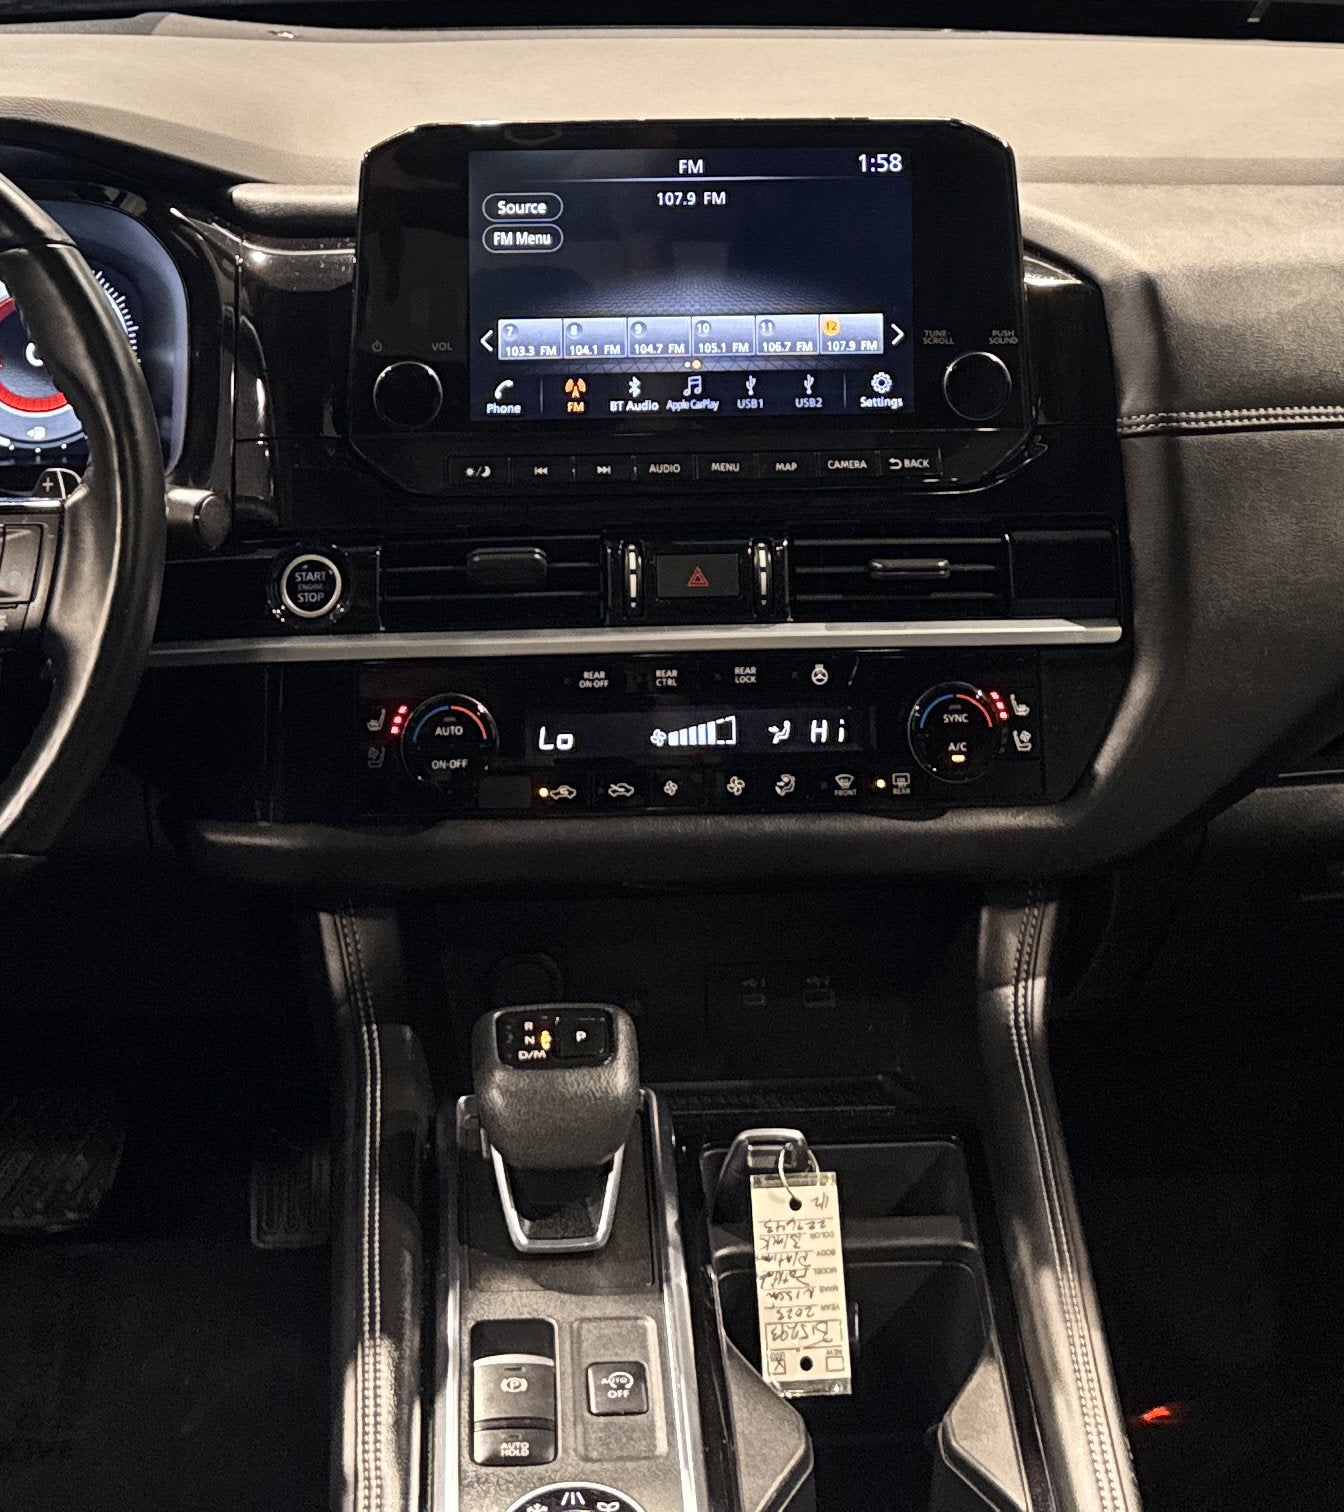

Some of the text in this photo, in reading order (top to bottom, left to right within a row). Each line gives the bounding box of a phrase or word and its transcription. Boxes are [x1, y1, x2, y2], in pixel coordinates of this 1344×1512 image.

[678, 159, 704, 175] FM
[858, 152, 903, 173] 1:58
[656, 191, 727, 207] 107.9 FM
[497, 199, 548, 216] Source
[493, 230, 552, 246] FM Menu
[506, 326, 514, 337] 7
[570, 325, 578, 336] 8
[635, 323, 643, 334] 9
[696, 323, 710, 334] 10
[761, 322, 773, 333] 11
[826, 321, 838, 331] 12
[992, 329, 1015, 337] PUSH
[431, 342, 453, 351] VOL
[762, 341, 813, 352] 106.7 FM
[827, 340, 878, 351] 107.9 FM
[923, 337, 955, 345] SCROLL
[989, 337, 1018, 345] SOUND
[505, 345, 557, 357] 103.3 FM
[570, 344, 621, 355] 104.1 FM
[634, 343, 685, 354] 104.7 FM
[698, 342, 749, 353] 105.1 FM
[567, 401, 585, 412] FM
[609, 400, 660, 412] BT Audio
[665, 400, 720, 412] Apple CarPlay
[737, 399, 764, 409] USB1
[795, 397, 823, 408] USB2
[859, 396, 904, 410] Settings
[486, 402, 522, 415] Phone
[649, 463, 681, 475] AUDIO
[711, 462, 740, 473] MENU
[775, 461, 798, 472] MAP
[827, 459, 867, 471] CAMERA
[904, 458, 930, 469] BACK
[295, 571, 327, 582] START
[297, 592, 325, 603] STOP
[583, 671, 606, 679] REAR
[656, 669, 678, 678] REAR
[734, 666, 757, 675] REAR
[656, 678, 678, 687] CTRL
[734, 674, 757, 683] LOCK
[943, 713, 968, 724] SYNC
[434, 725, 464, 736] AUTO
[810, 718, 845, 743] Hi
[538, 725, 574, 751] Lo
[948, 741, 967, 752] A/C
[524, 1021, 534, 1031] R
[524, 1035, 535, 1045] N
[576, 1030, 587, 1043] P
[518, 1049, 547, 1061] D/M
[810, 1231, 835, 1239] COLOR
[820, 1303, 841, 1311] YEAR
[607, 1390, 630, 1399] OFF
[500, 1441, 530, 1450] AUTO
[500, 1449, 530, 1458] HOLD
